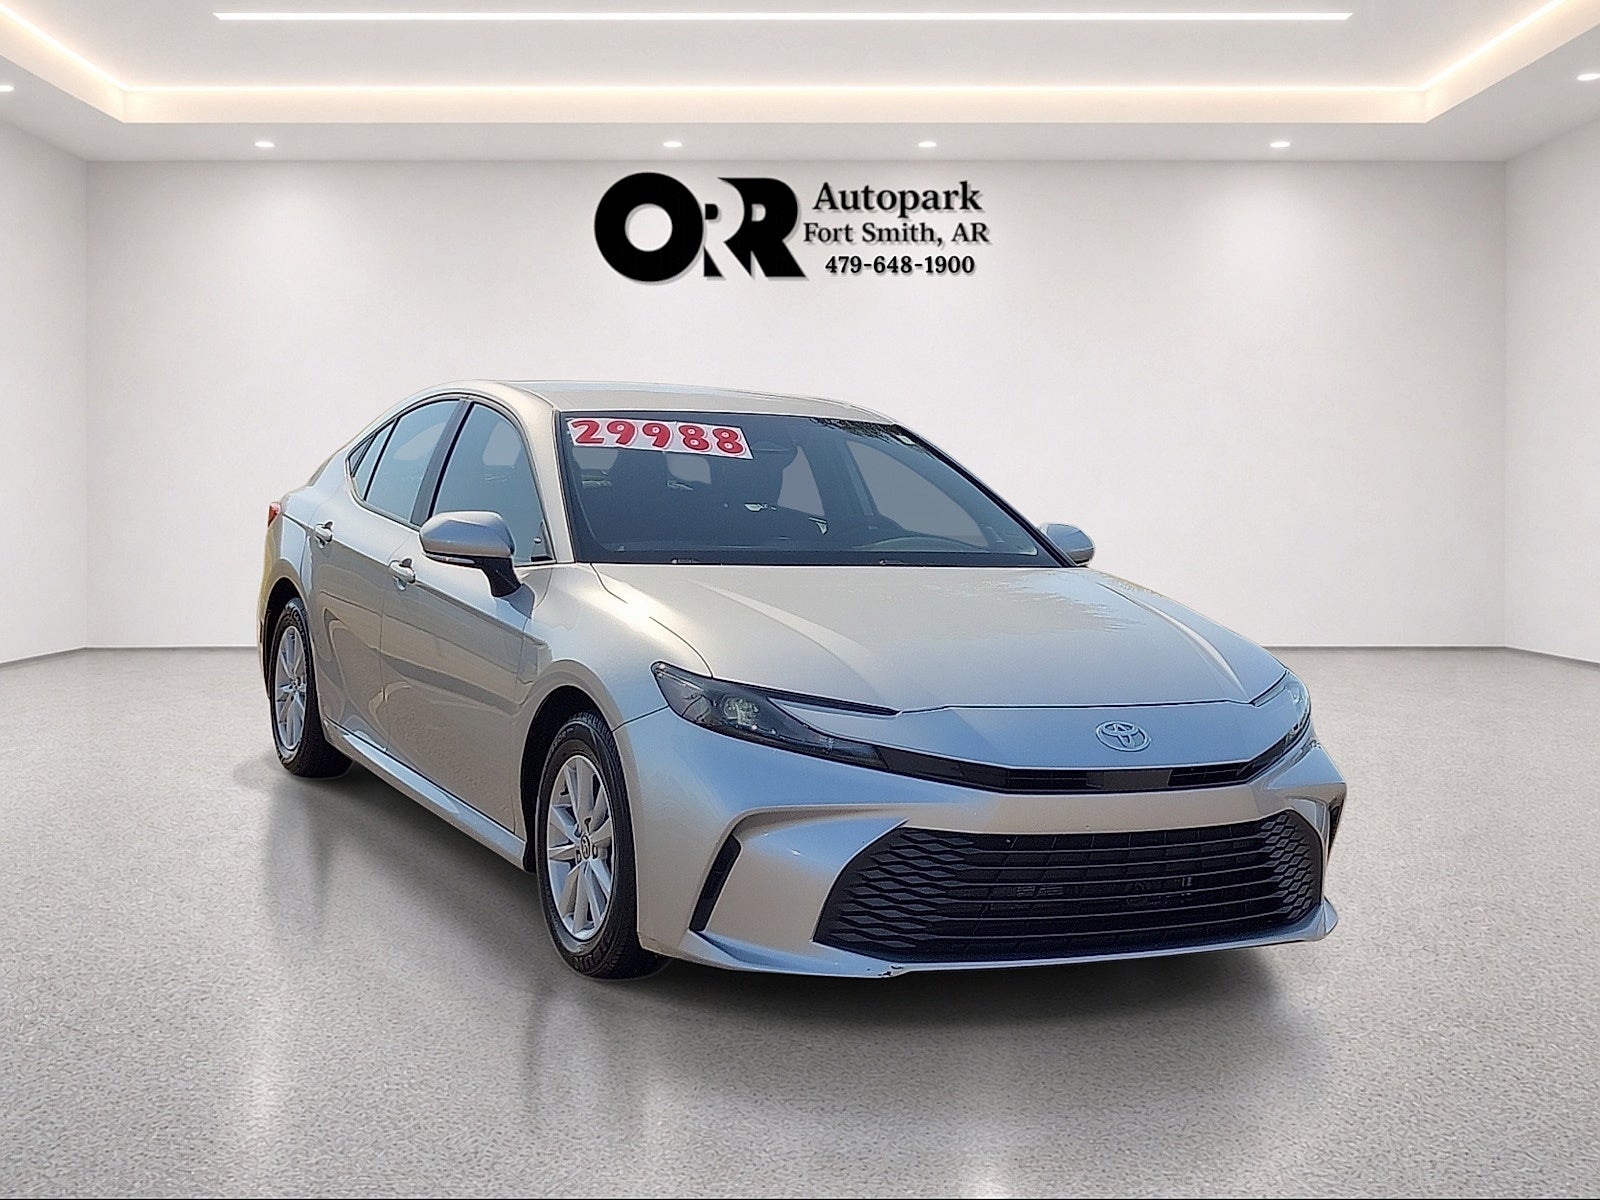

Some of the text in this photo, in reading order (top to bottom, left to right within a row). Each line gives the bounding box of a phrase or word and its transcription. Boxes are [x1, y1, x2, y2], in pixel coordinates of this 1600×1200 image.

[813, 181, 982, 217] Autopark
[594, 172, 807, 281] ORR
[803, 222, 990, 246] Fort Smith, AR
[825, 255, 975, 274] 479-648-1900
[570, 419, 745, 454] 29988
